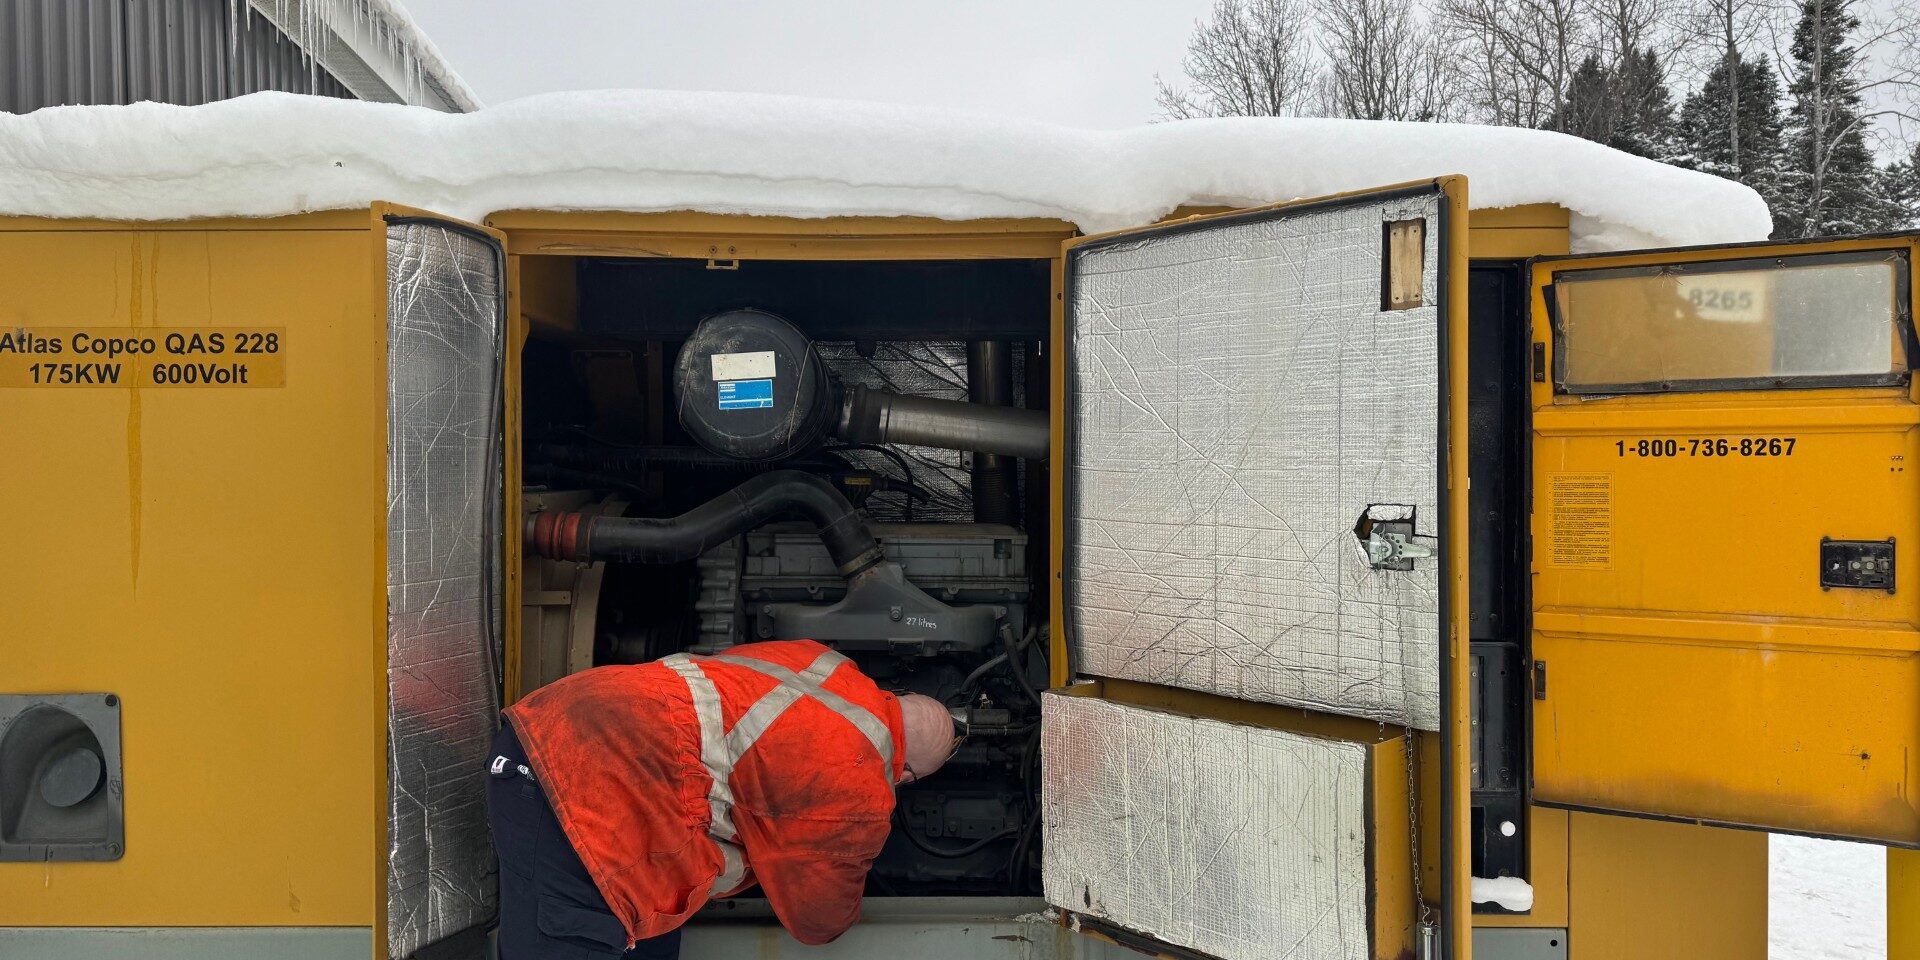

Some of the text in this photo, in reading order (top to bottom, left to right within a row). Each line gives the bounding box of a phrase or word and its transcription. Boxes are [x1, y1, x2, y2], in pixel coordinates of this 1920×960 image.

[0, 333, 279, 358] Atlas Copco QAS 228
[29, 363, 248, 384] 175KW 600Volt
[1615, 438, 1796, 457] 1-800-736-8267
[906, 617, 937, 629] 27 litres
